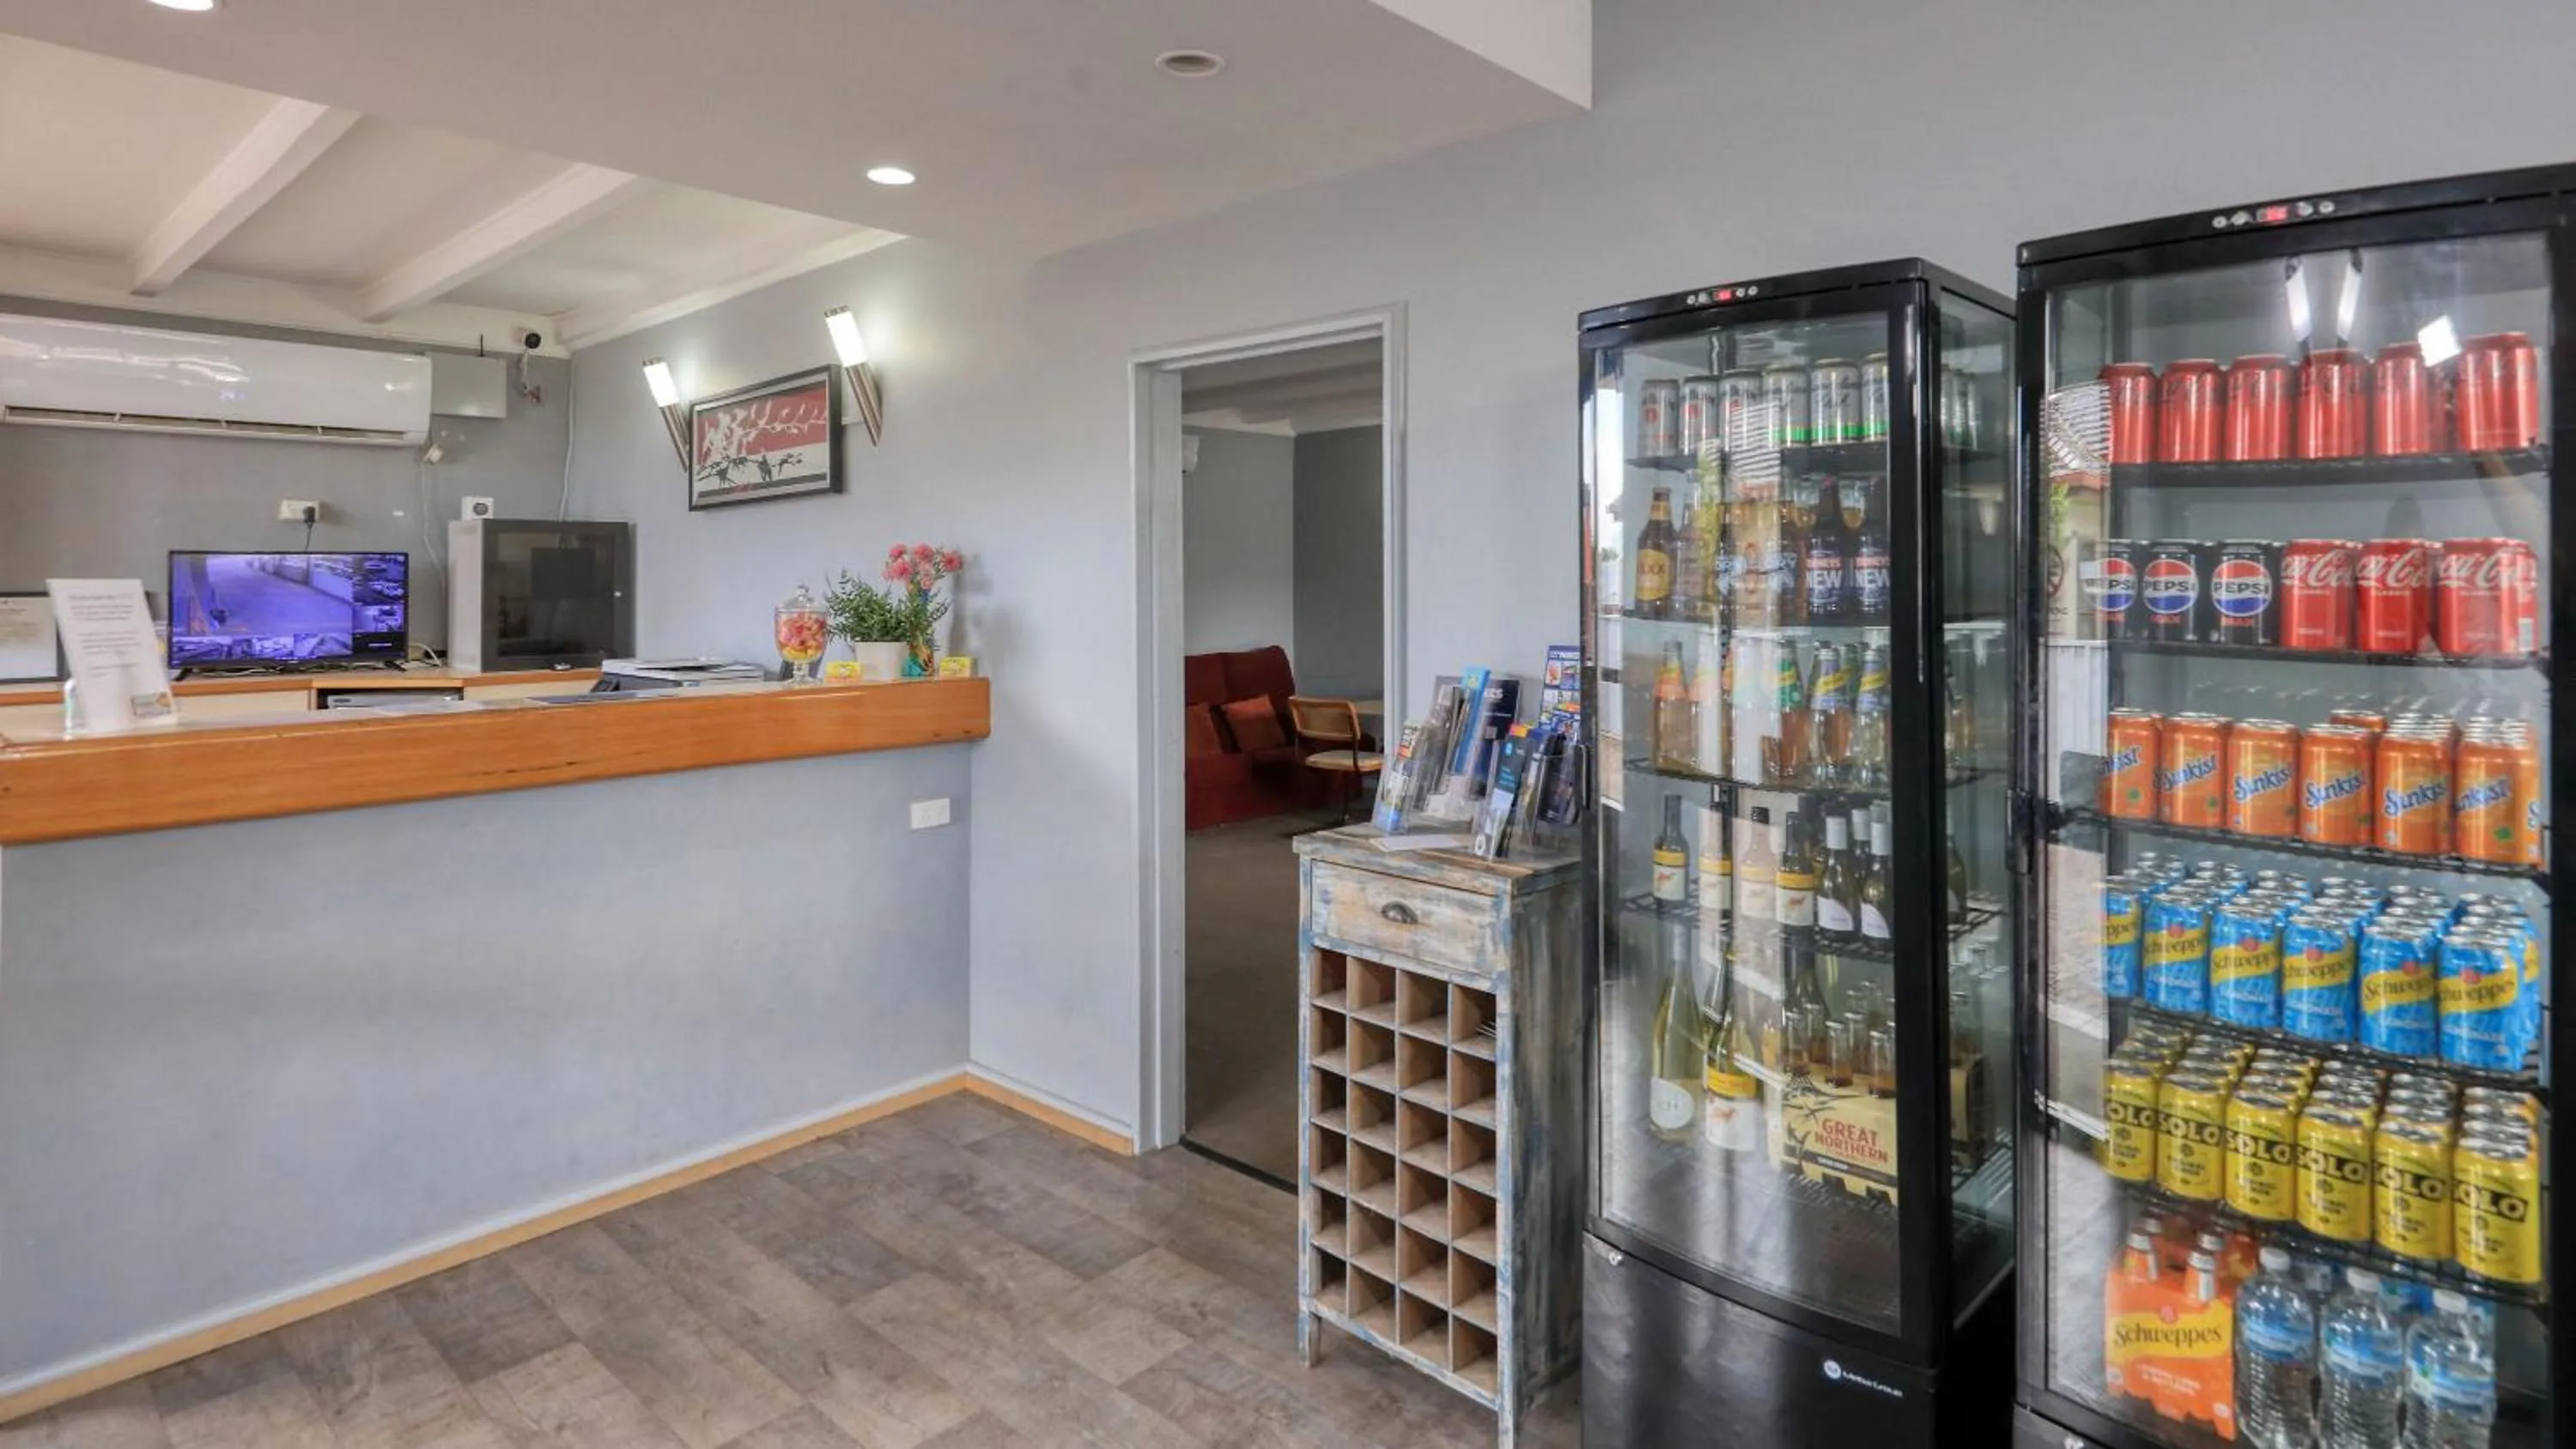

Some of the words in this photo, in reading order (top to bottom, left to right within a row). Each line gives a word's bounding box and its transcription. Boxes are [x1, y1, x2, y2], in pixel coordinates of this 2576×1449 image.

[2214, 582, 2269, 594] PEPSI
[2106, 1101, 2154, 1126] OLO
[1821, 1117, 1879, 1148] GREAT
[1814, 1130, 1888, 1164] NORTHERN
[2113, 1322, 2223, 1349] Schweppes
